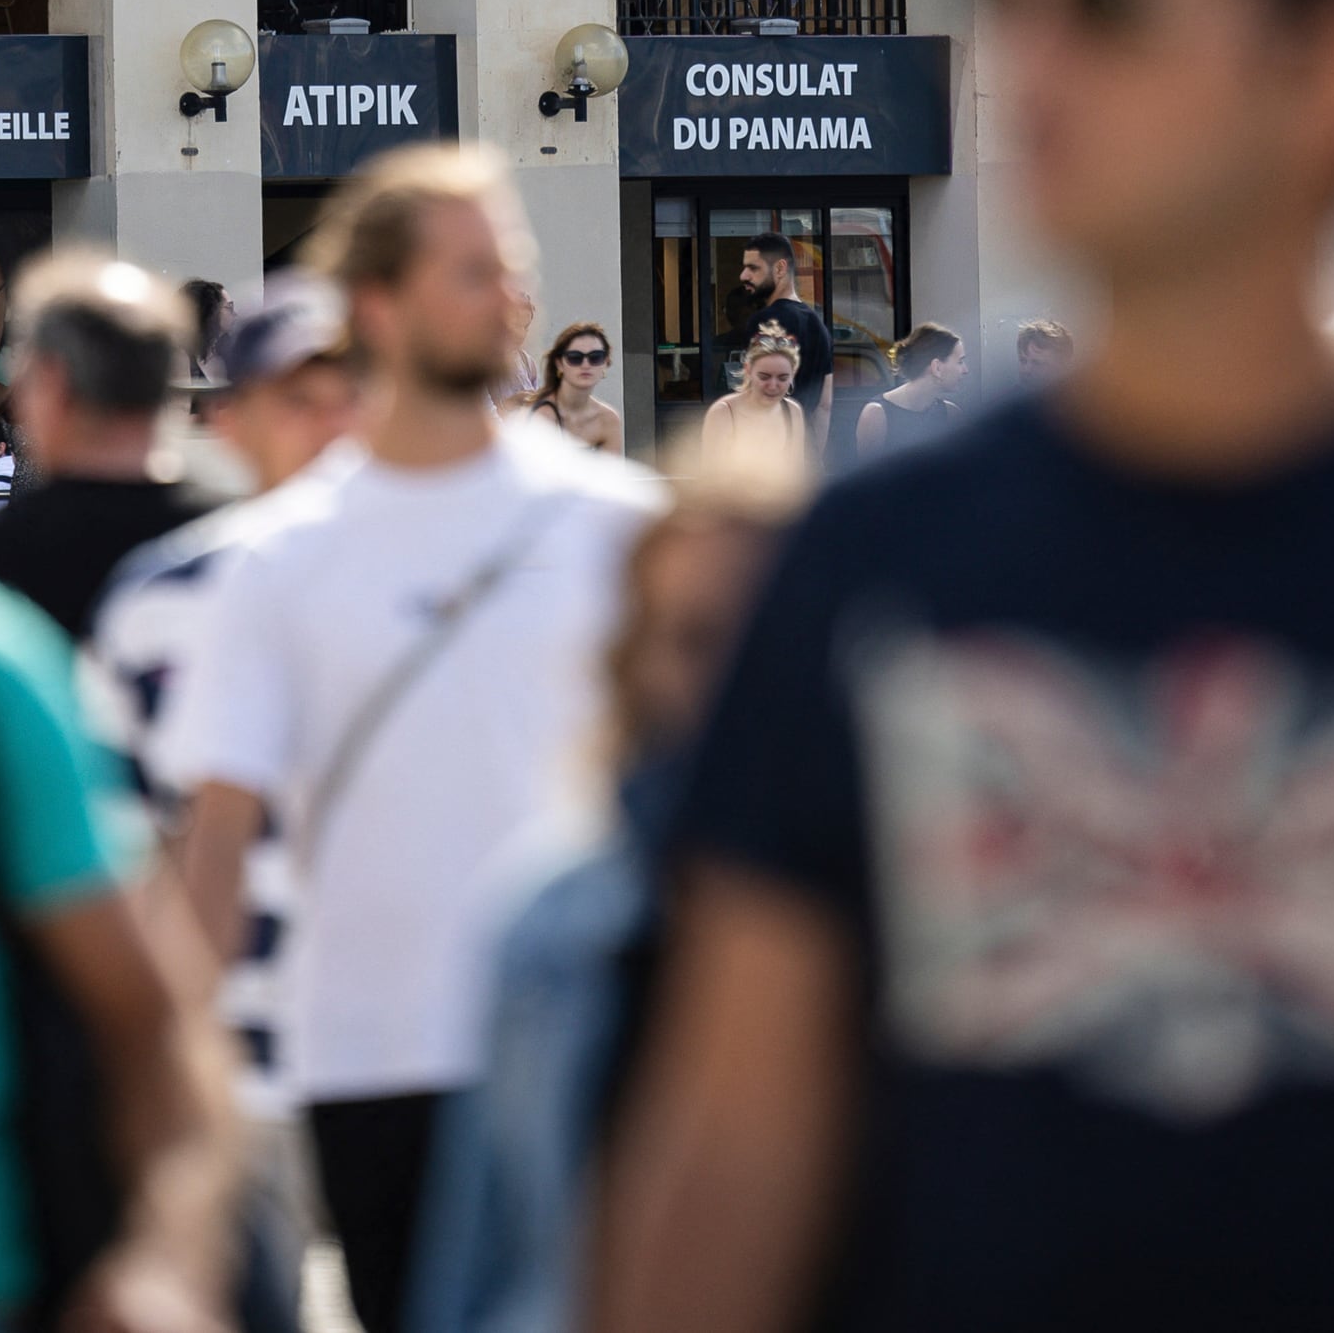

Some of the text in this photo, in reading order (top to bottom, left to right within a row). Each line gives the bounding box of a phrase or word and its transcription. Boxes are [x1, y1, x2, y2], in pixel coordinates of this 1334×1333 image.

[686, 63, 858, 97] CONSULAT
[283, 84, 418, 126] ATIPIK
[673, 117, 873, 150] DU PANAMA
